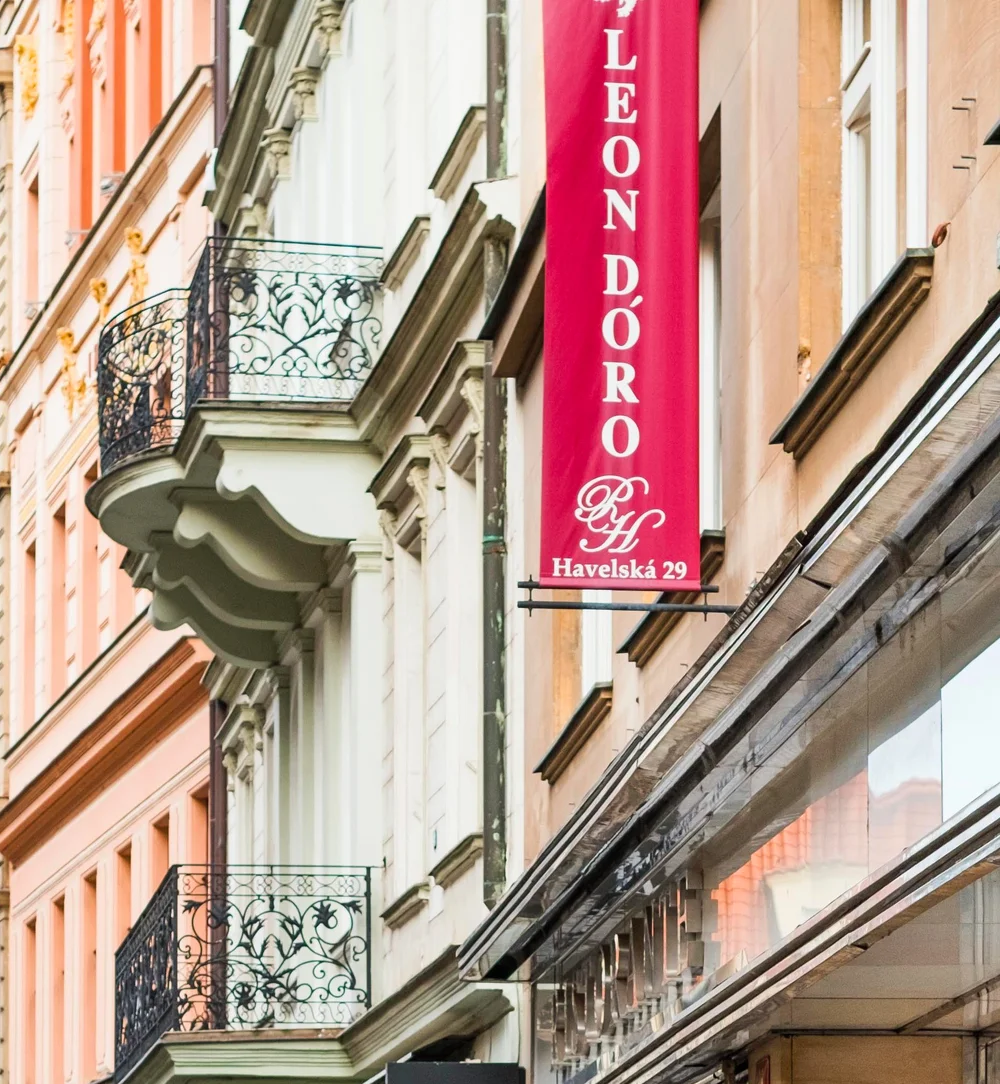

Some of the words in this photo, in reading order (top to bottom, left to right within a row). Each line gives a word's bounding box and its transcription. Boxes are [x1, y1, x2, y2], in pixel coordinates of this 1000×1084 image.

[602, 28, 640, 232] LEON
[552, 557, 657, 579] Havelská
[662, 561, 687, 580] 29
